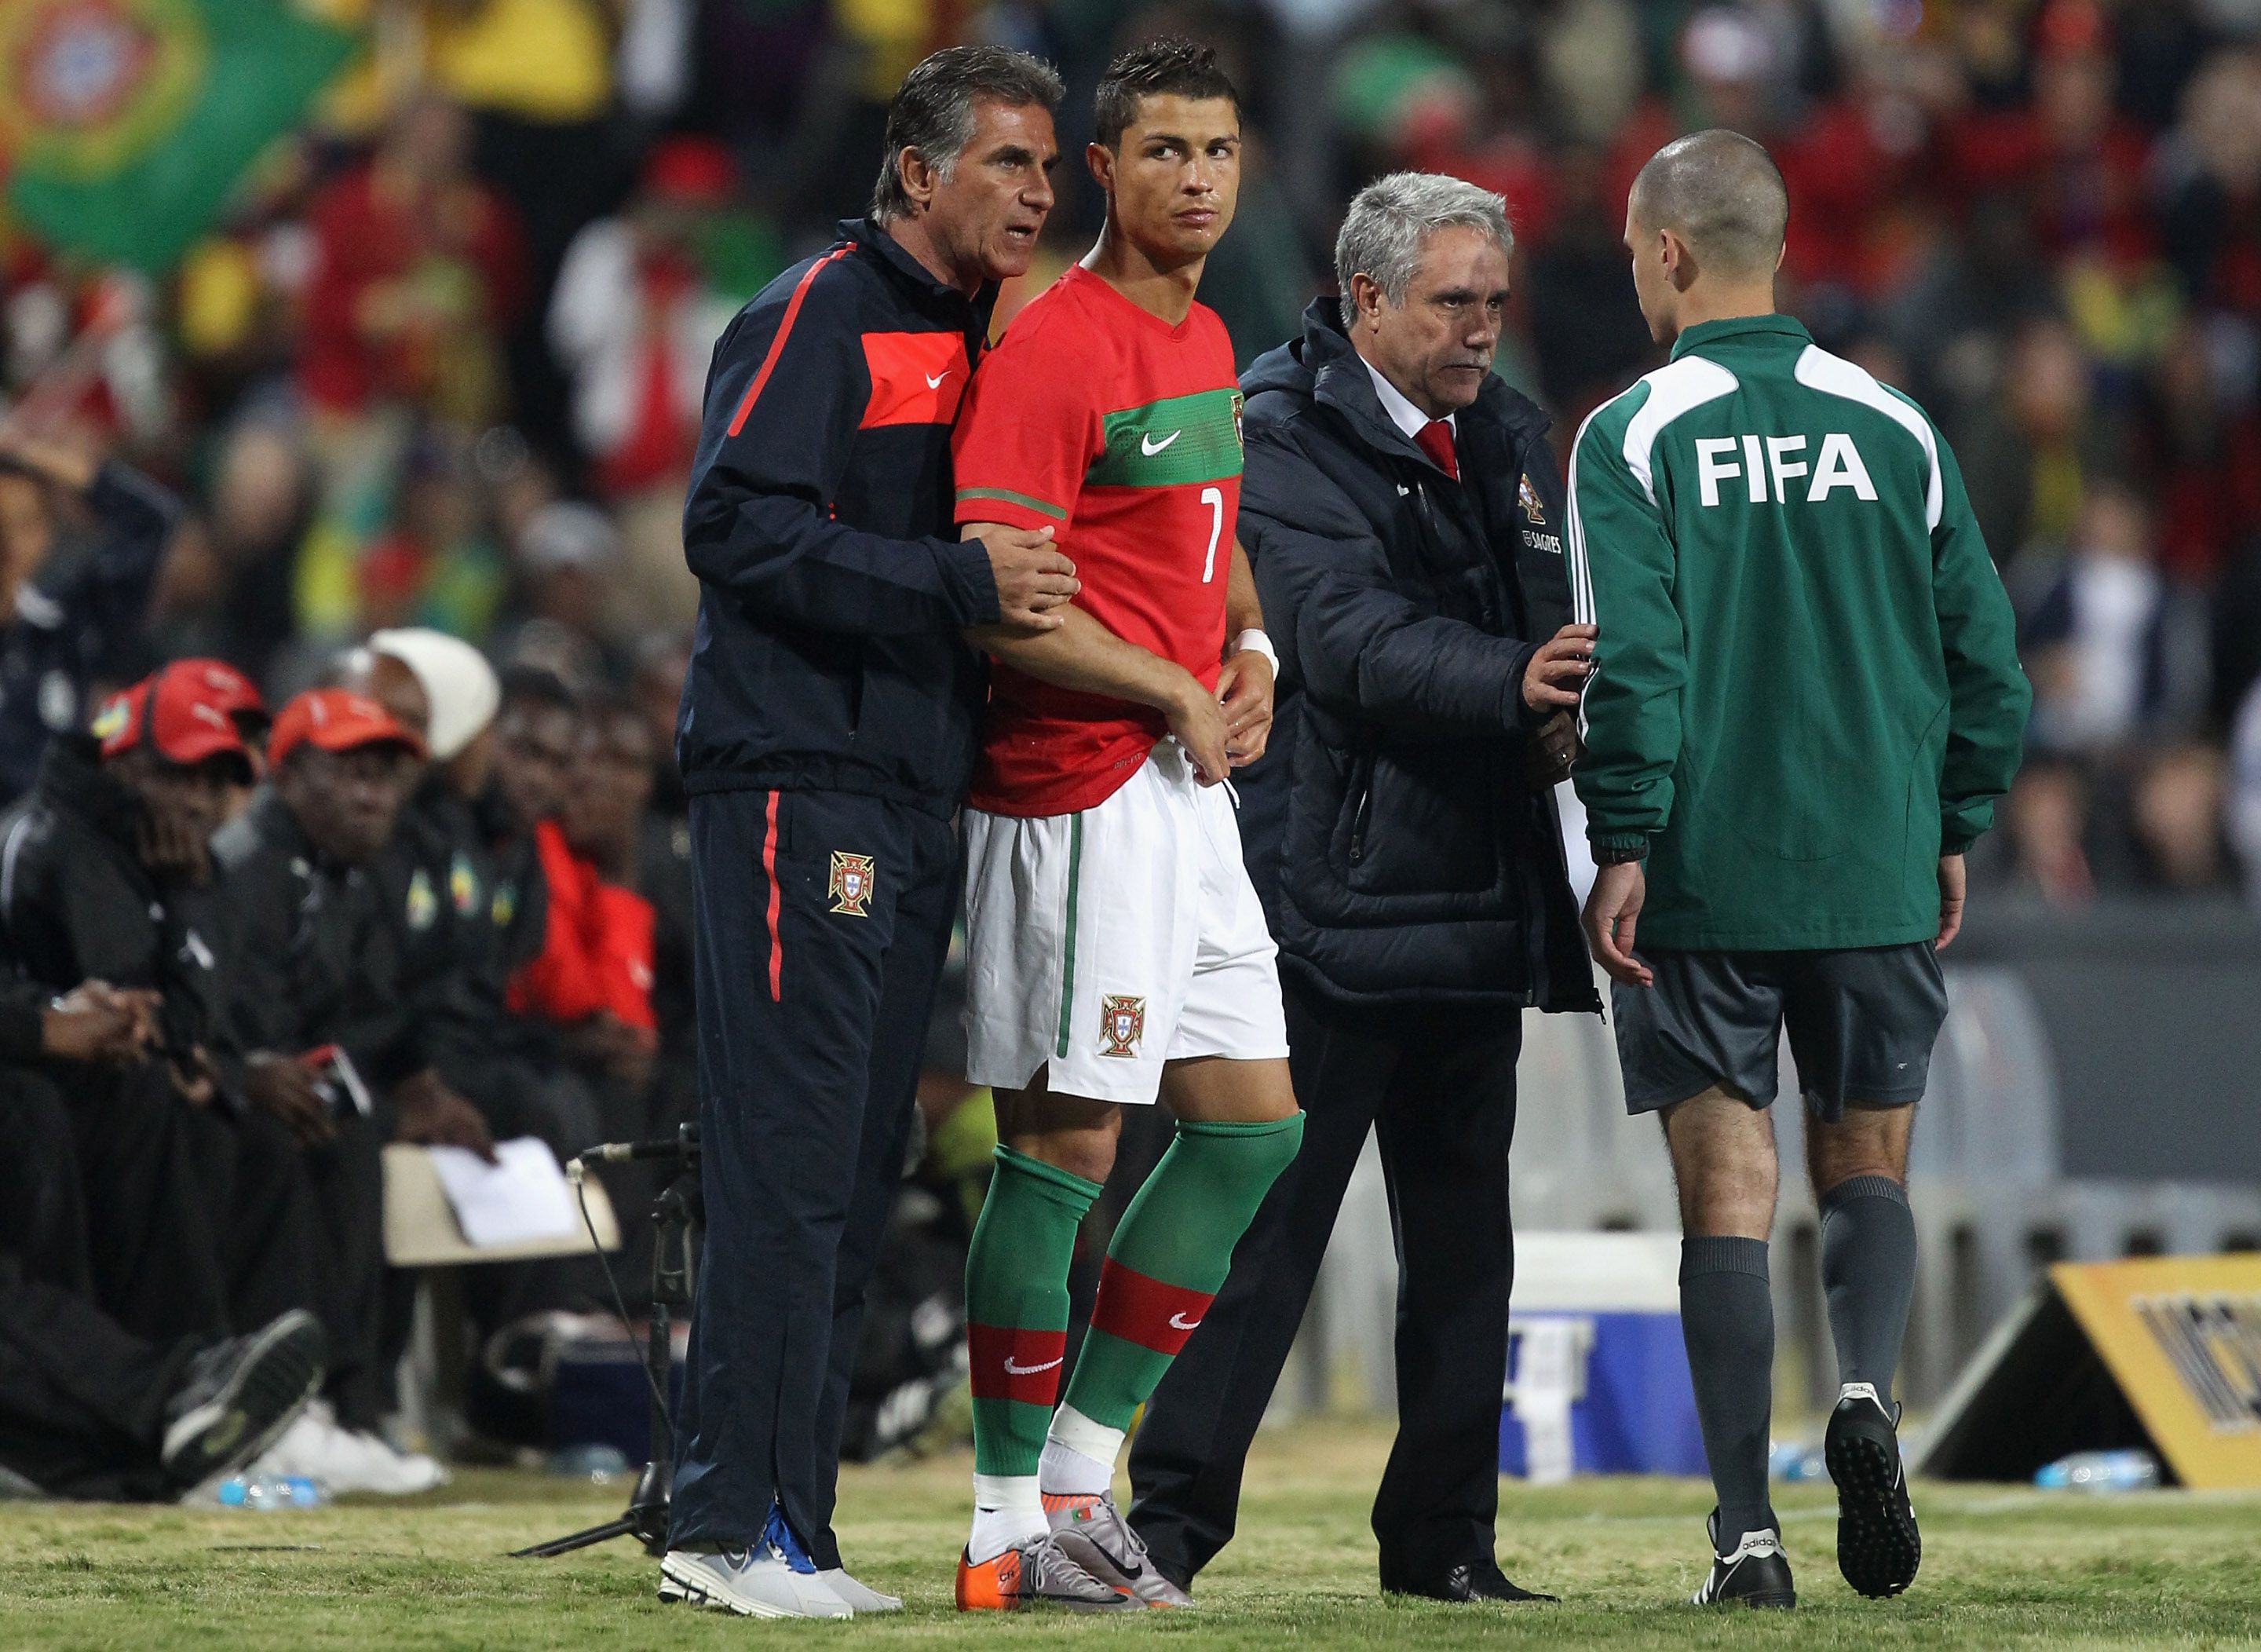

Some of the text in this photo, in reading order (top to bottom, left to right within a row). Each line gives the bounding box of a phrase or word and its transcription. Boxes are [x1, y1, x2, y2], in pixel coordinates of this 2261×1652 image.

[1695, 433, 1879, 506] FIFA
[1200, 488, 1222, 583] 7
[1532, 532, 1562, 554] SAGRES
[1743, 1538, 1777, 1550] adidas
